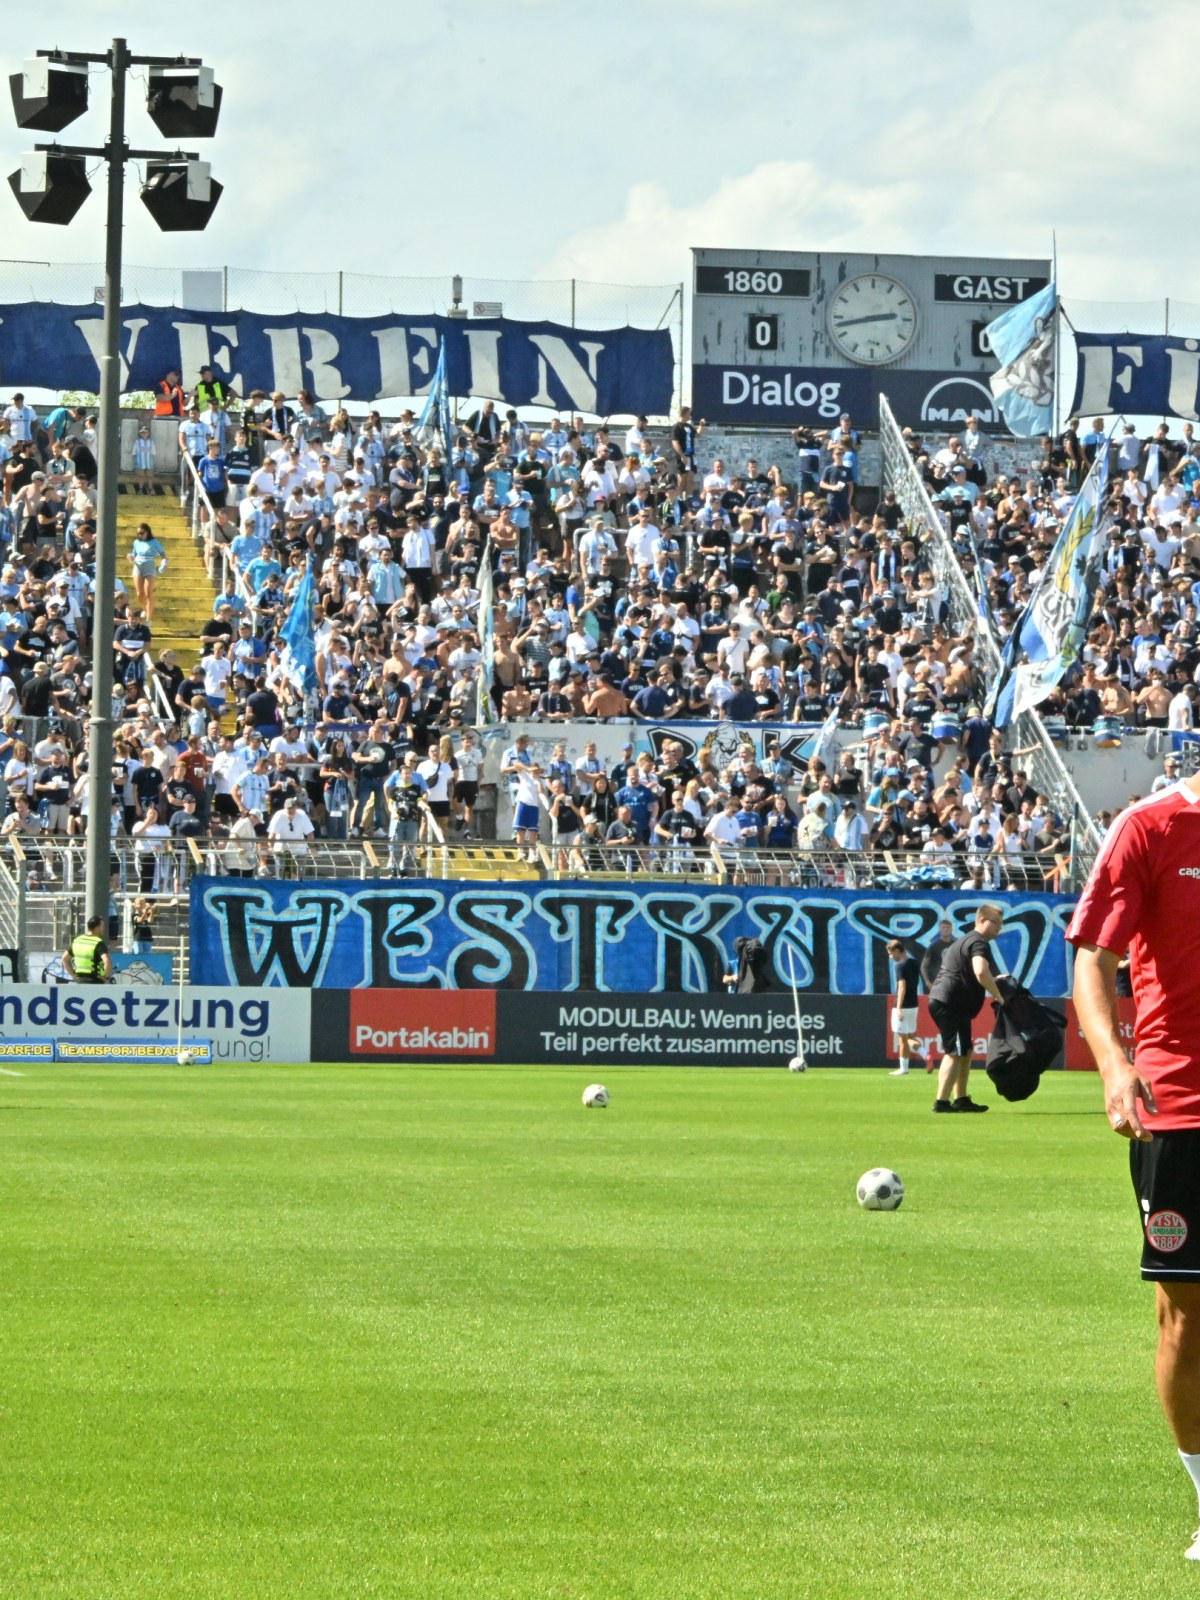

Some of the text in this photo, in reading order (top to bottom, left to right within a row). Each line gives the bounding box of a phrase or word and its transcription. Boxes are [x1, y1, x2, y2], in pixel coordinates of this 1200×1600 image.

[724, 270, 782, 294] 1860
[953, 276, 1029, 301] GAST
[755, 321, 772, 347] 0
[74, 317, 605, 414] VEREIN
[722, 371, 841, 418] Dialog
[927, 407, 994, 422] MAN
[0, 986, 270, 1037] ndsetzung
[559, 1006, 825, 1034] MODULBAU: Wenn jedes
[355, 1025, 490, 1051] Portakabin
[540, 1032, 843, 1059] Teil perfekt zusammenspielt
[1149, 1226, 1186, 1235] LANDSBERG
[1156, 1214, 1179, 1227] TSV
[1155, 1236, 1179, 1249] 1882
